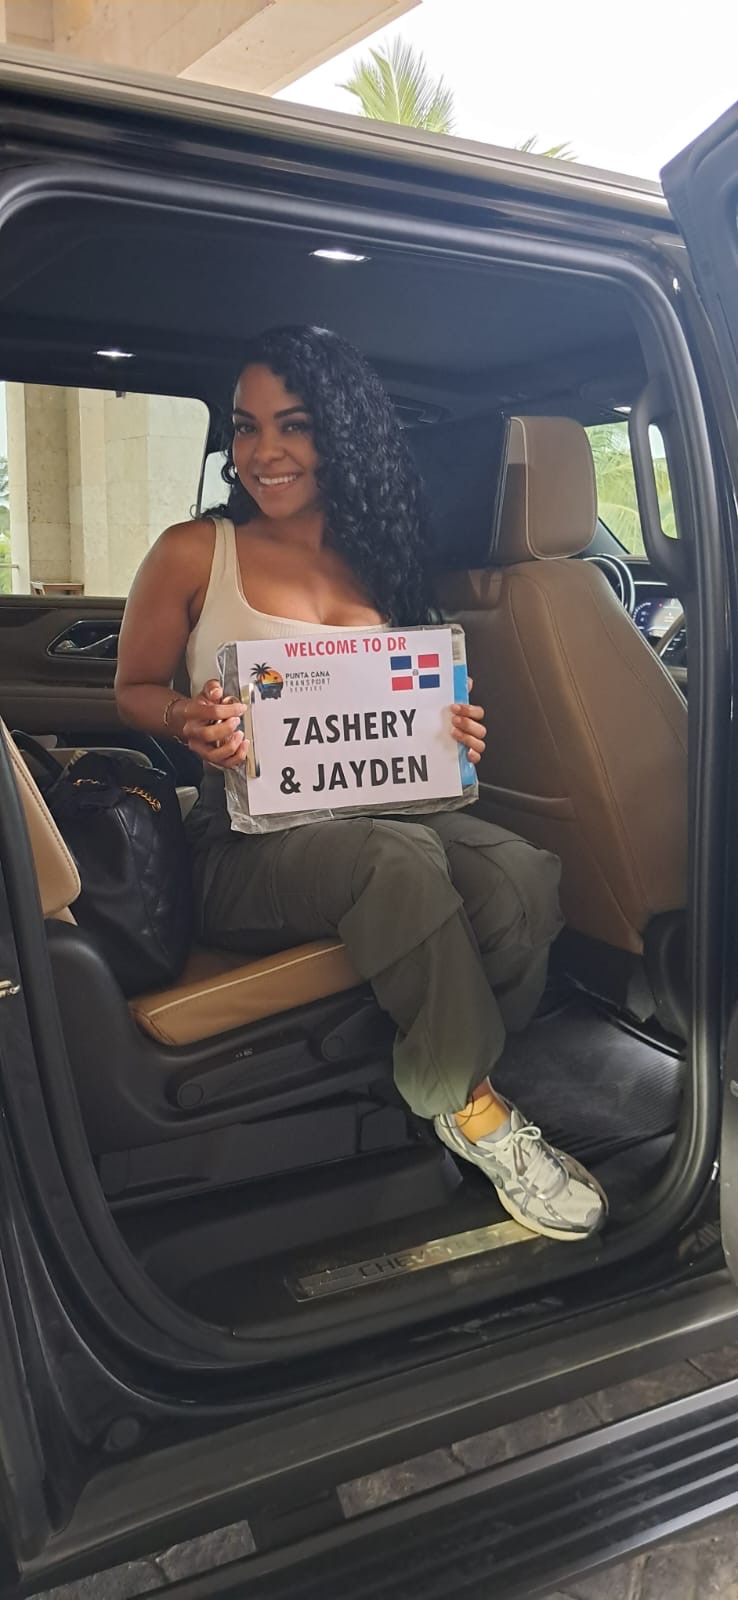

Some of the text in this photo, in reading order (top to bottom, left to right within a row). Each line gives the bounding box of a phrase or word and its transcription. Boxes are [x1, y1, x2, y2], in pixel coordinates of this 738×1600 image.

[285, 636, 407, 658] WELCOME TO DR
[285, 678, 330, 687] TRANSPORT
[283, 709, 417, 746] ZASHERY
[280, 755, 428, 794] & JAYDEN
